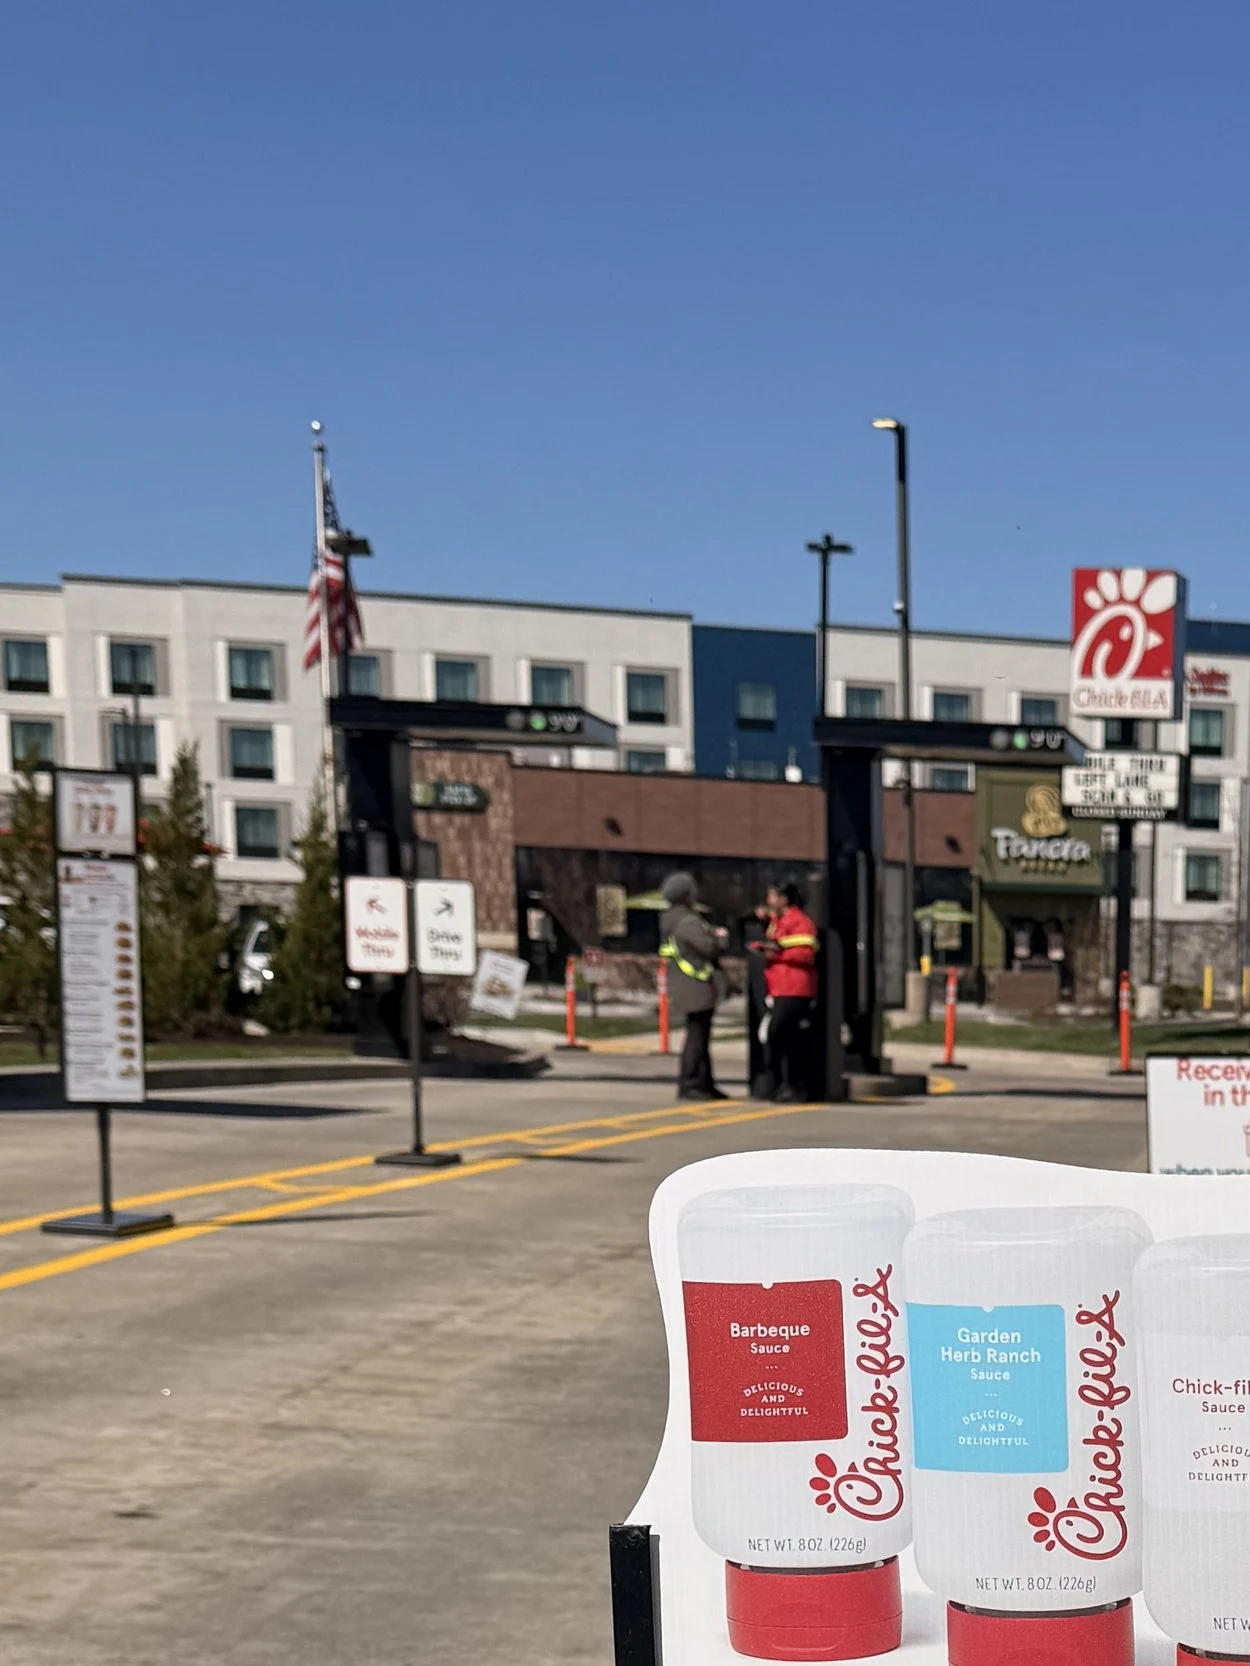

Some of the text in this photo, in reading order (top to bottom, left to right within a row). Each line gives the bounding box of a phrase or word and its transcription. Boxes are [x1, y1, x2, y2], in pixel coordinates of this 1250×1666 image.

[991, 826, 1091, 861] Panera
[1203, 1084, 1225, 1107] in
[730, 1322, 811, 1341] Barbeque
[957, 1327, 1021, 1345] Garden
[750, 1342, 790, 1354] Sauce
[941, 1346, 1041, 1365] Herb Ranch
[970, 1367, 1011, 1381] Sauce
[742, 1381, 805, 1399] DELICIOUS
[834, 1264, 905, 1522] Chick-fil-A
[762, 1393, 784, 1405] AND
[1201, 1400, 1246, 1414] Sauce
[740, 1406, 809, 1417] DELIGHTFUL
[961, 1409, 1024, 1428] DELICIOUS
[981, 1421, 1004, 1433] AND
[1053, 1290, 1131, 1561] Chick-fil-A
[958, 1435, 1029, 1447] DELIGHTFUL
[1213, 1457, 1238, 1468] AND
[748, 1538, 770, 1552] NET
[773, 1538, 797, 1552] WT.
[798, 1538, 806, 1552] 8
[829, 1537, 867, 1554] (226g)
[975, 1577, 999, 1591] NET
[1001, 1577, 1026, 1591] WT.
[1027, 1576, 1035, 1591] 8
[1059, 1575, 1097, 1594] (226g)
[1213, 1617, 1237, 1631] NET
